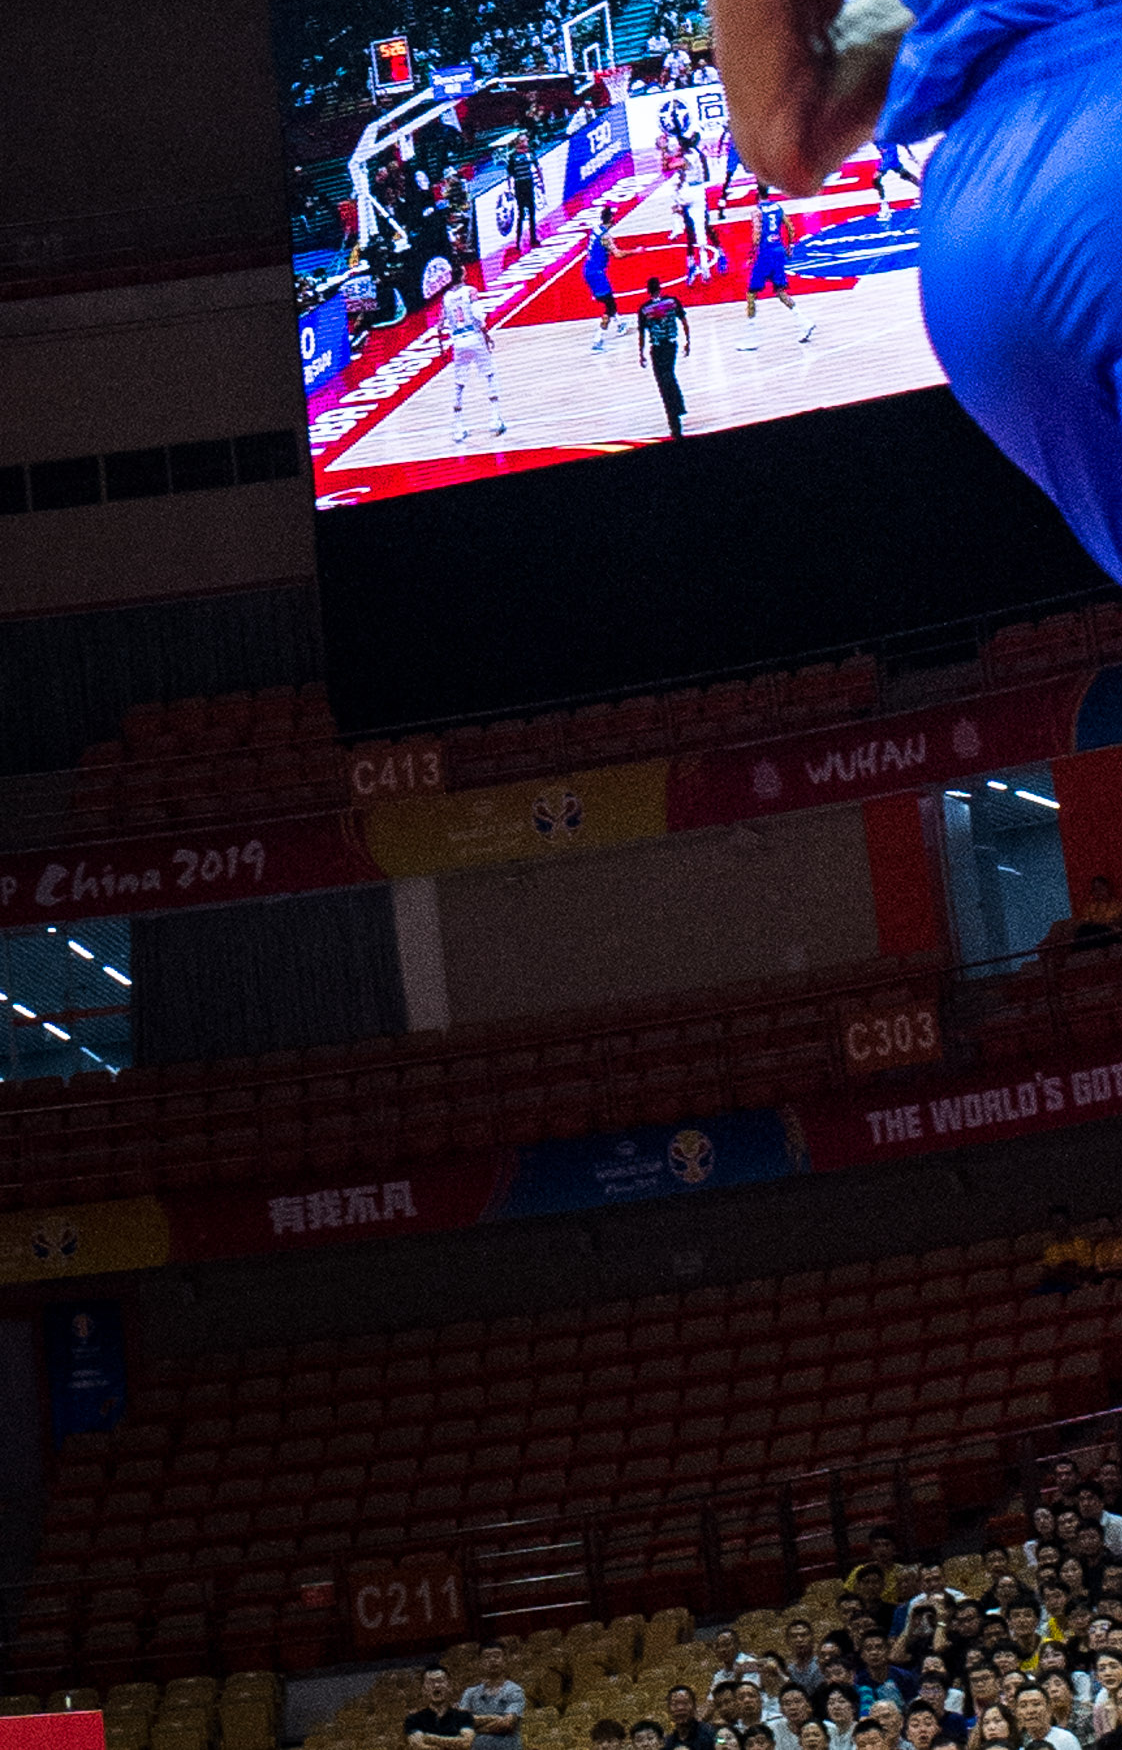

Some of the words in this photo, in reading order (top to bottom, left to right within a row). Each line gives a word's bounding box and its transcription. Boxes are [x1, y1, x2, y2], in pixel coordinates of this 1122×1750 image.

[352, 751, 441, 795] C413
[805, 734, 927, 786] WUHAN
[34, 862, 162, 908] China
[172, 840, 267, 887] 2019
[846, 1012, 937, 1061] C303
[866, 1109, 923, 1146] THE
[930, 1071, 1065, 1135] WORLD'S
[267, 1180, 418, 1235] 有我不凡
[357, 1574, 460, 1630] C211
